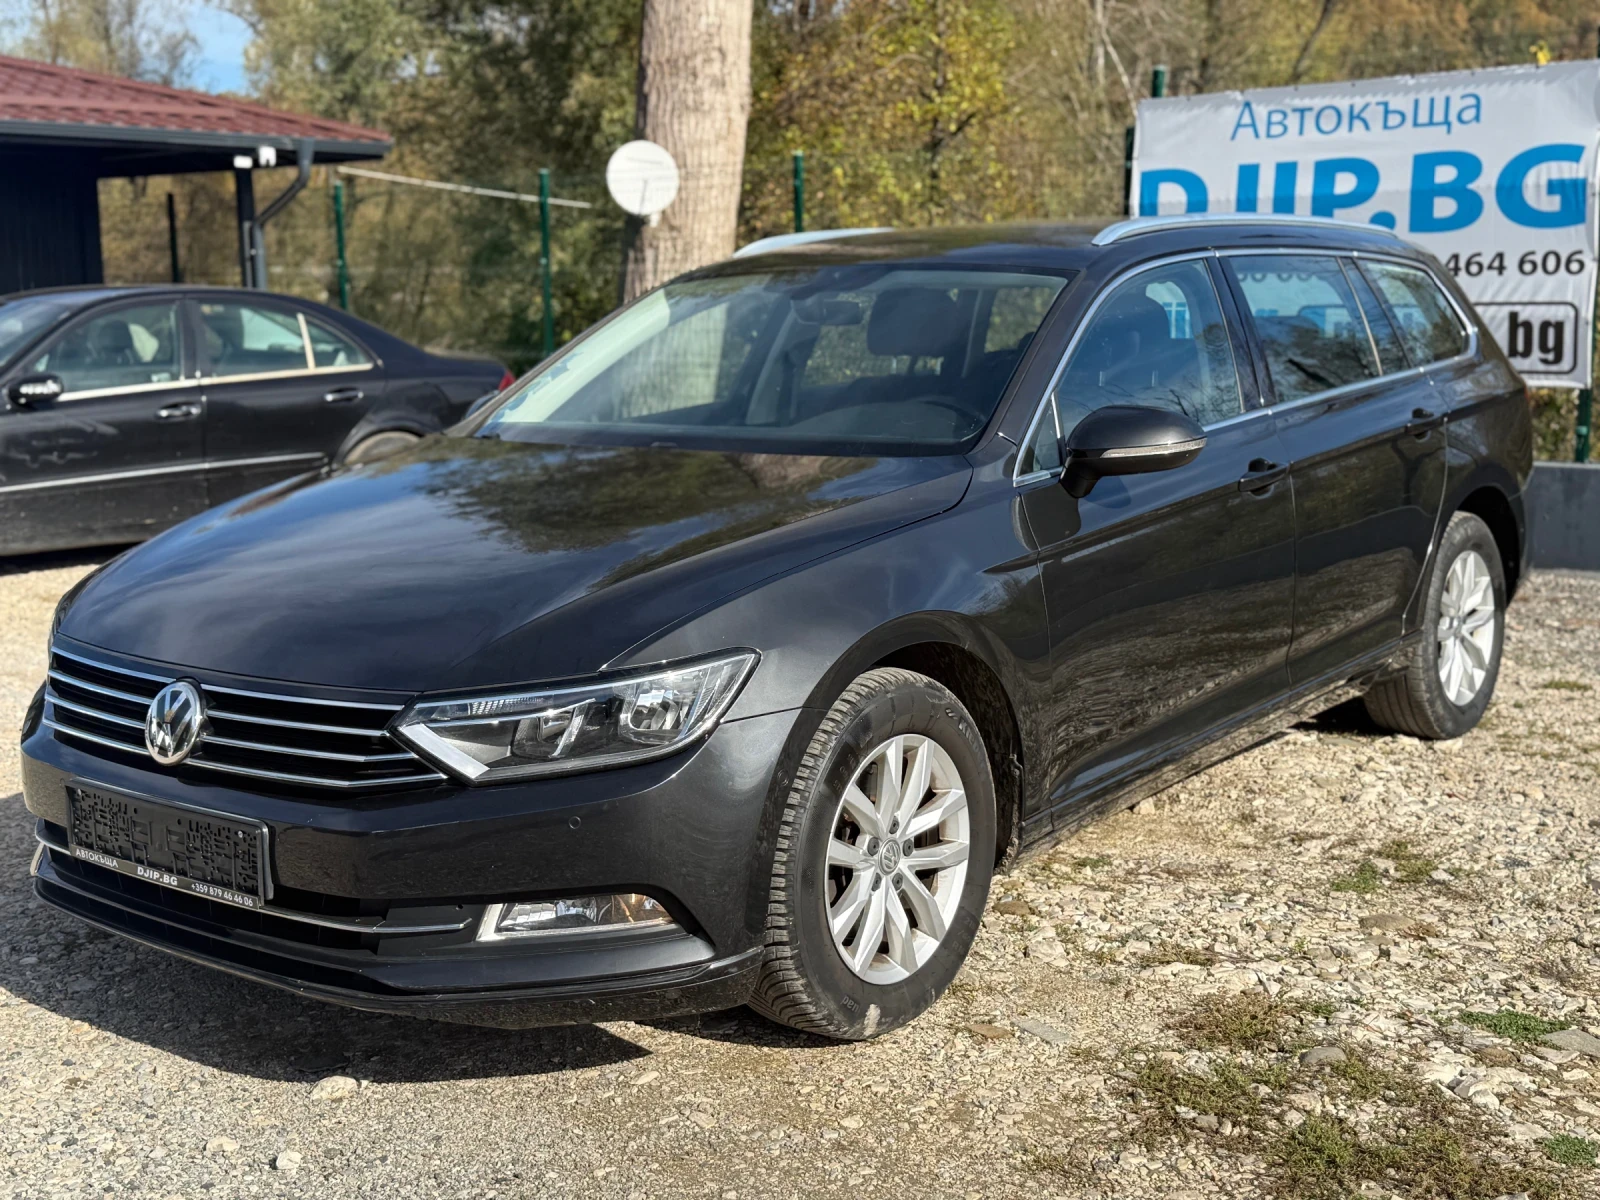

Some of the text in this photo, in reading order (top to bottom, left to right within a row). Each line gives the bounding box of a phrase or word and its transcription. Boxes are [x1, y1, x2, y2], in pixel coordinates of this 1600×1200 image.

[1230, 93, 1482, 141] Автокъща
[1446, 250, 1586, 277] 464 606
[75, 848, 254, 907] АВТОКЪЩА DJIP.BG +359 879 46 46 06
